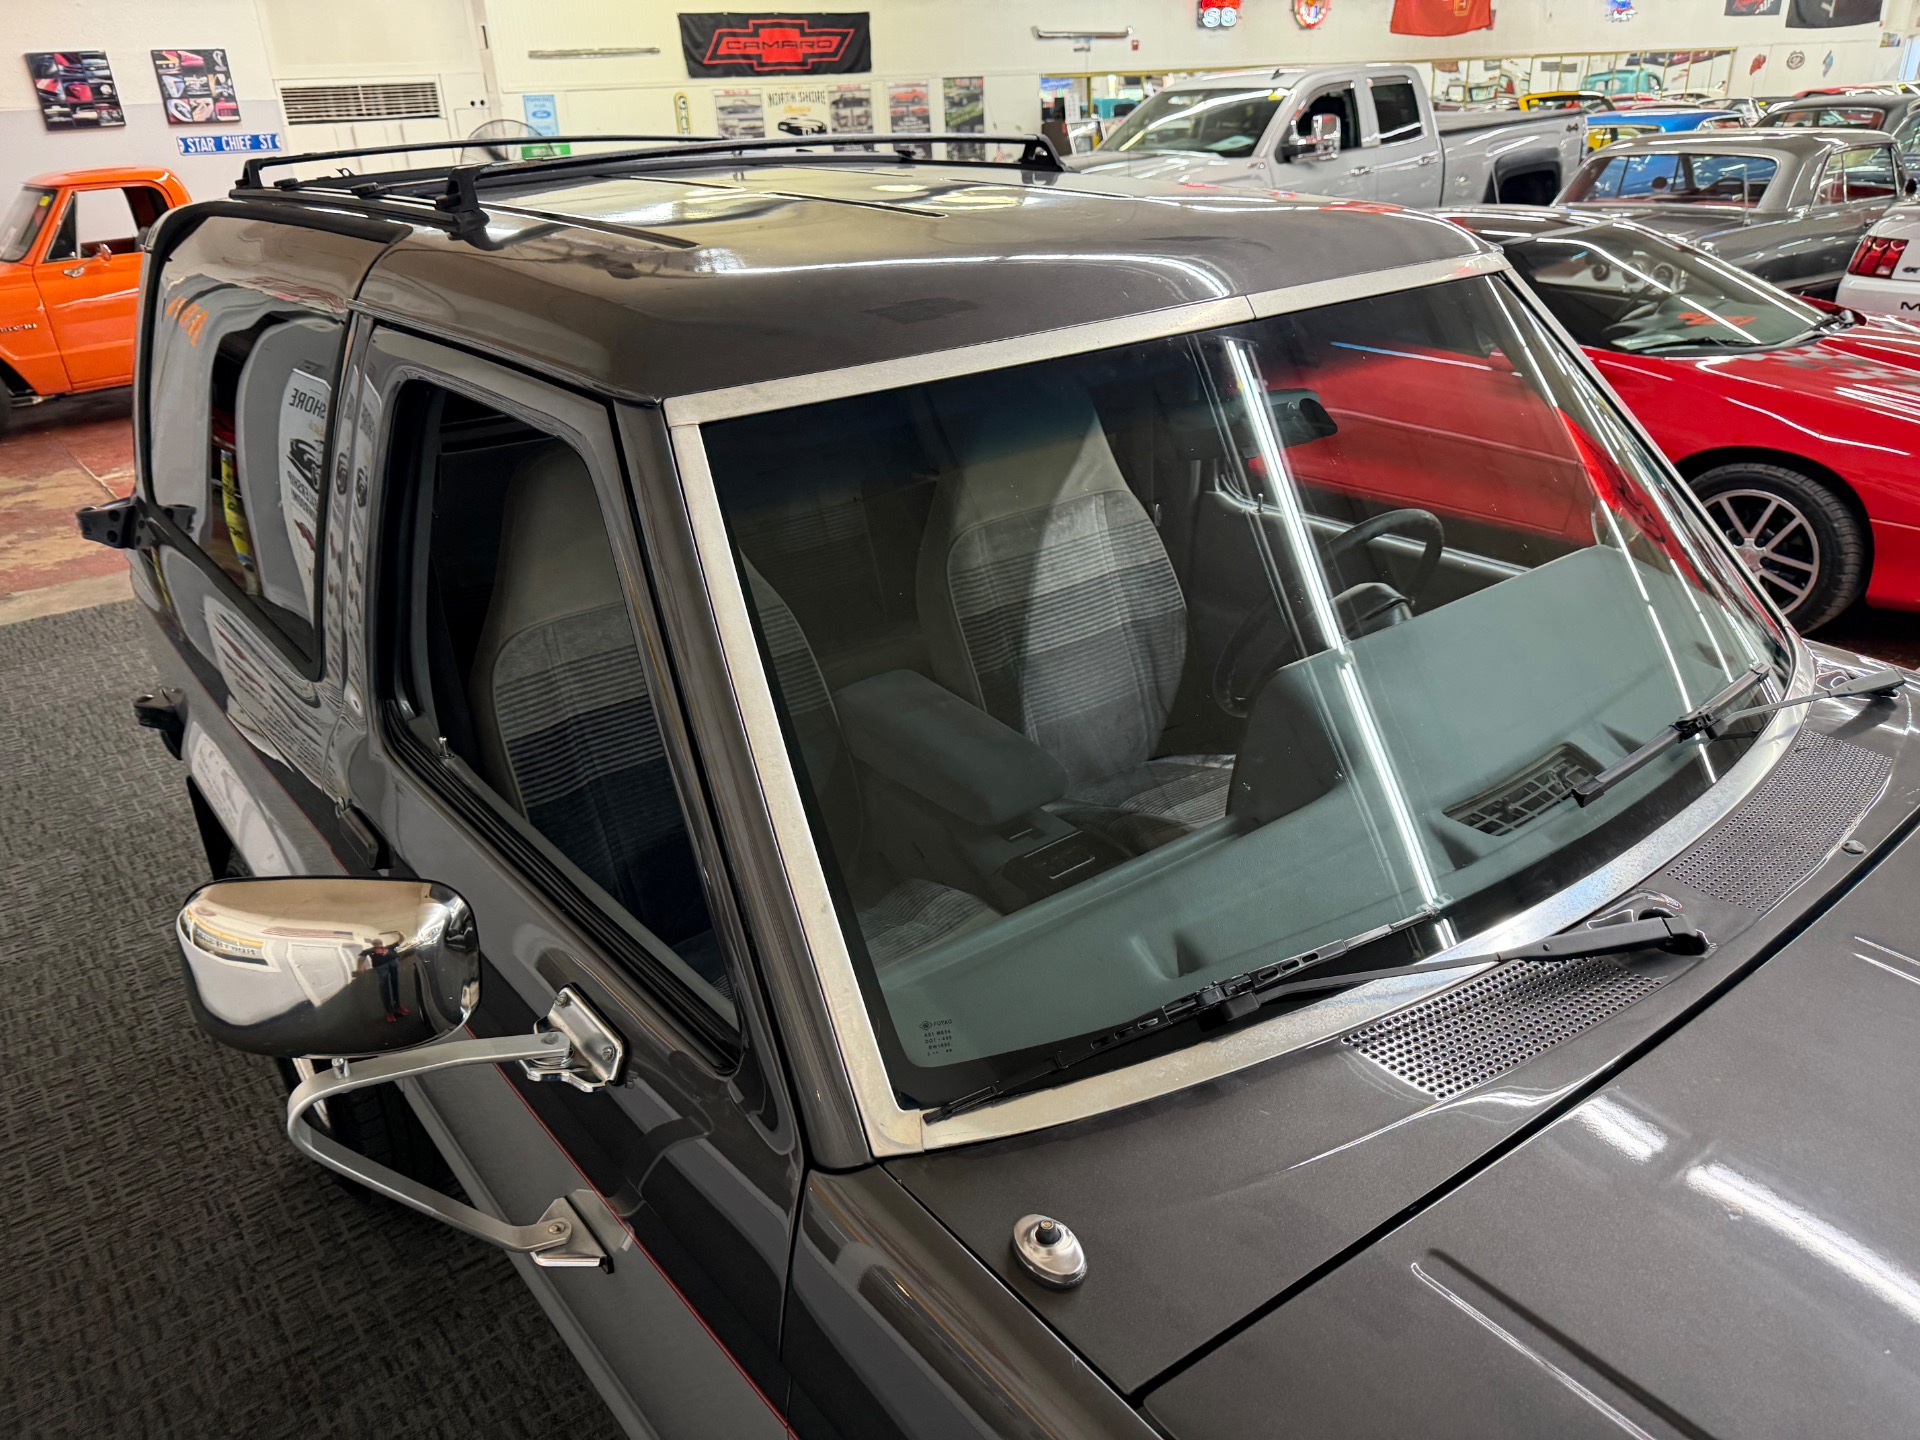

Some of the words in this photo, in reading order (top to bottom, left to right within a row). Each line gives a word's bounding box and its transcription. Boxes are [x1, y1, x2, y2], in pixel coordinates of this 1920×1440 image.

[1202, 7, 1237, 27] SS
[725, 39, 834, 50] CAMARO
[187, 137, 216, 153] STAR
[221, 134, 252, 151] CHIEF
[258, 134, 273, 149] ST
[933, 1019, 953, 1027] FUYAO
